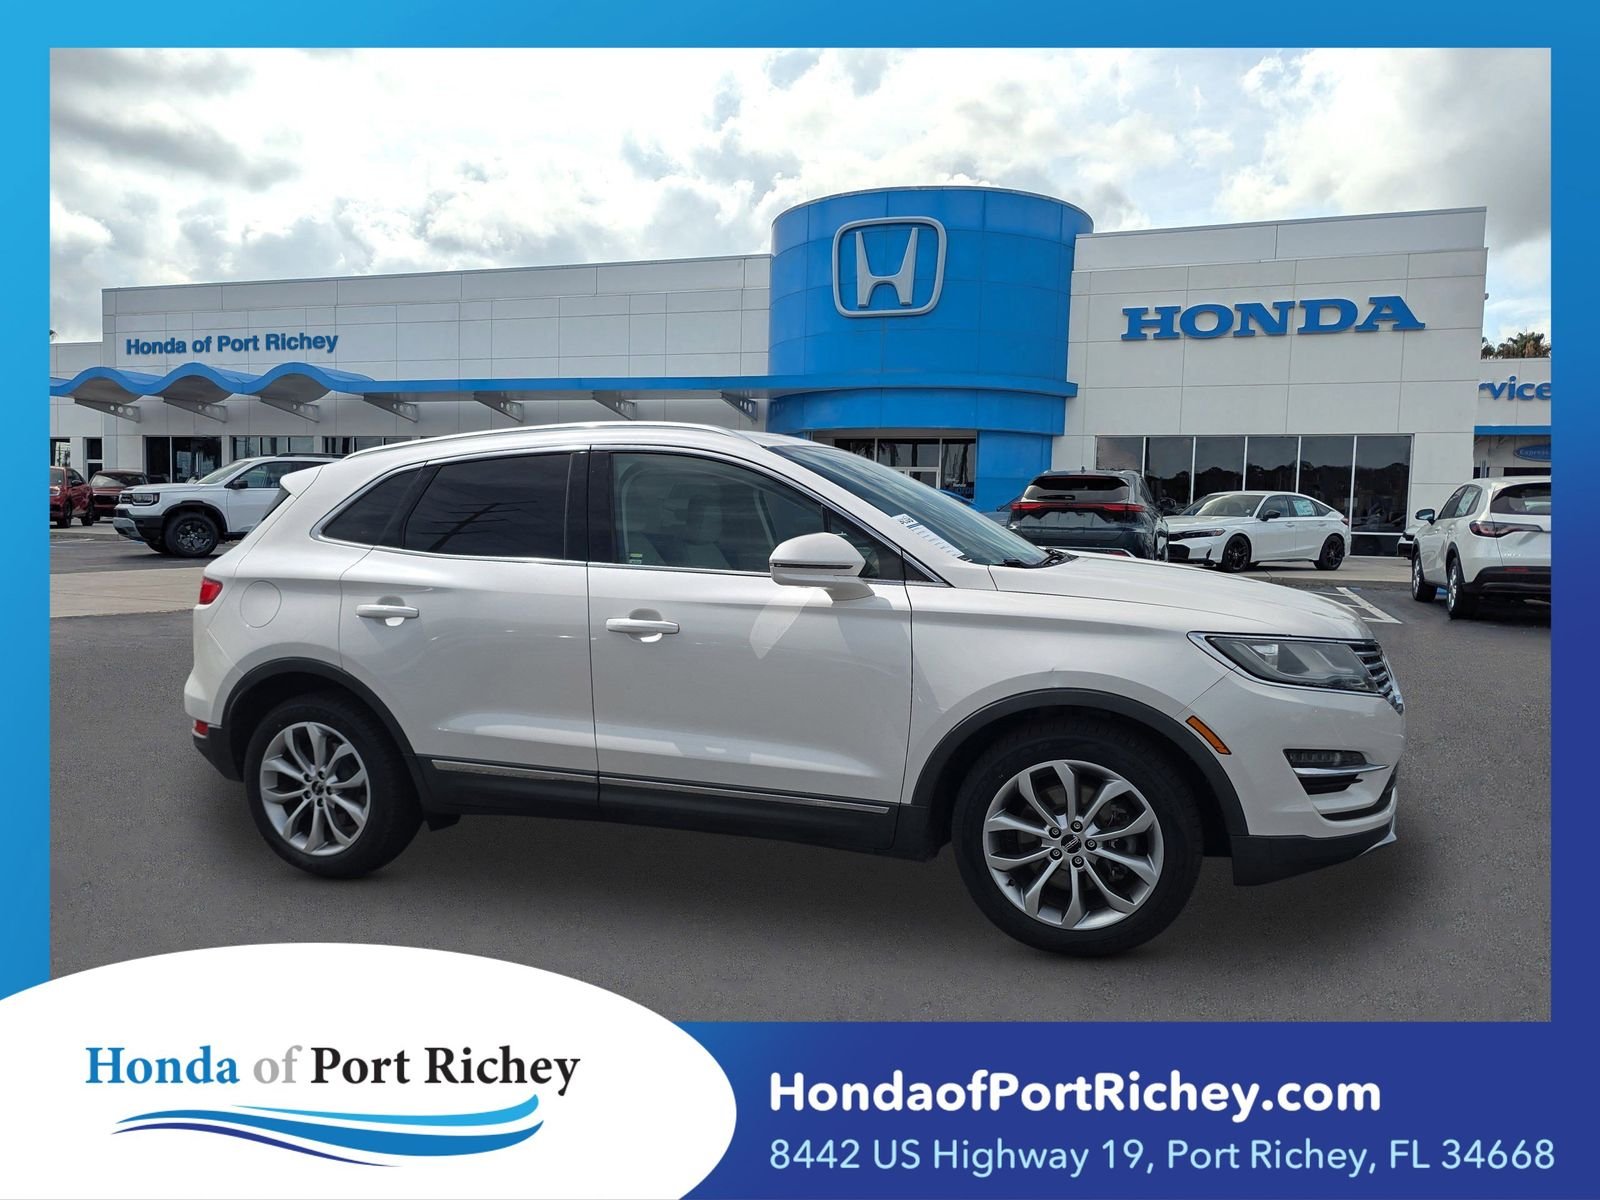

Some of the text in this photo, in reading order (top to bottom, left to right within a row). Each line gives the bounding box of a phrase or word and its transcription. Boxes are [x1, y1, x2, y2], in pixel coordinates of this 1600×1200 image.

[1120, 295, 1426, 341] HONDA
[125, 332, 339, 355] Honda of Port Richey
